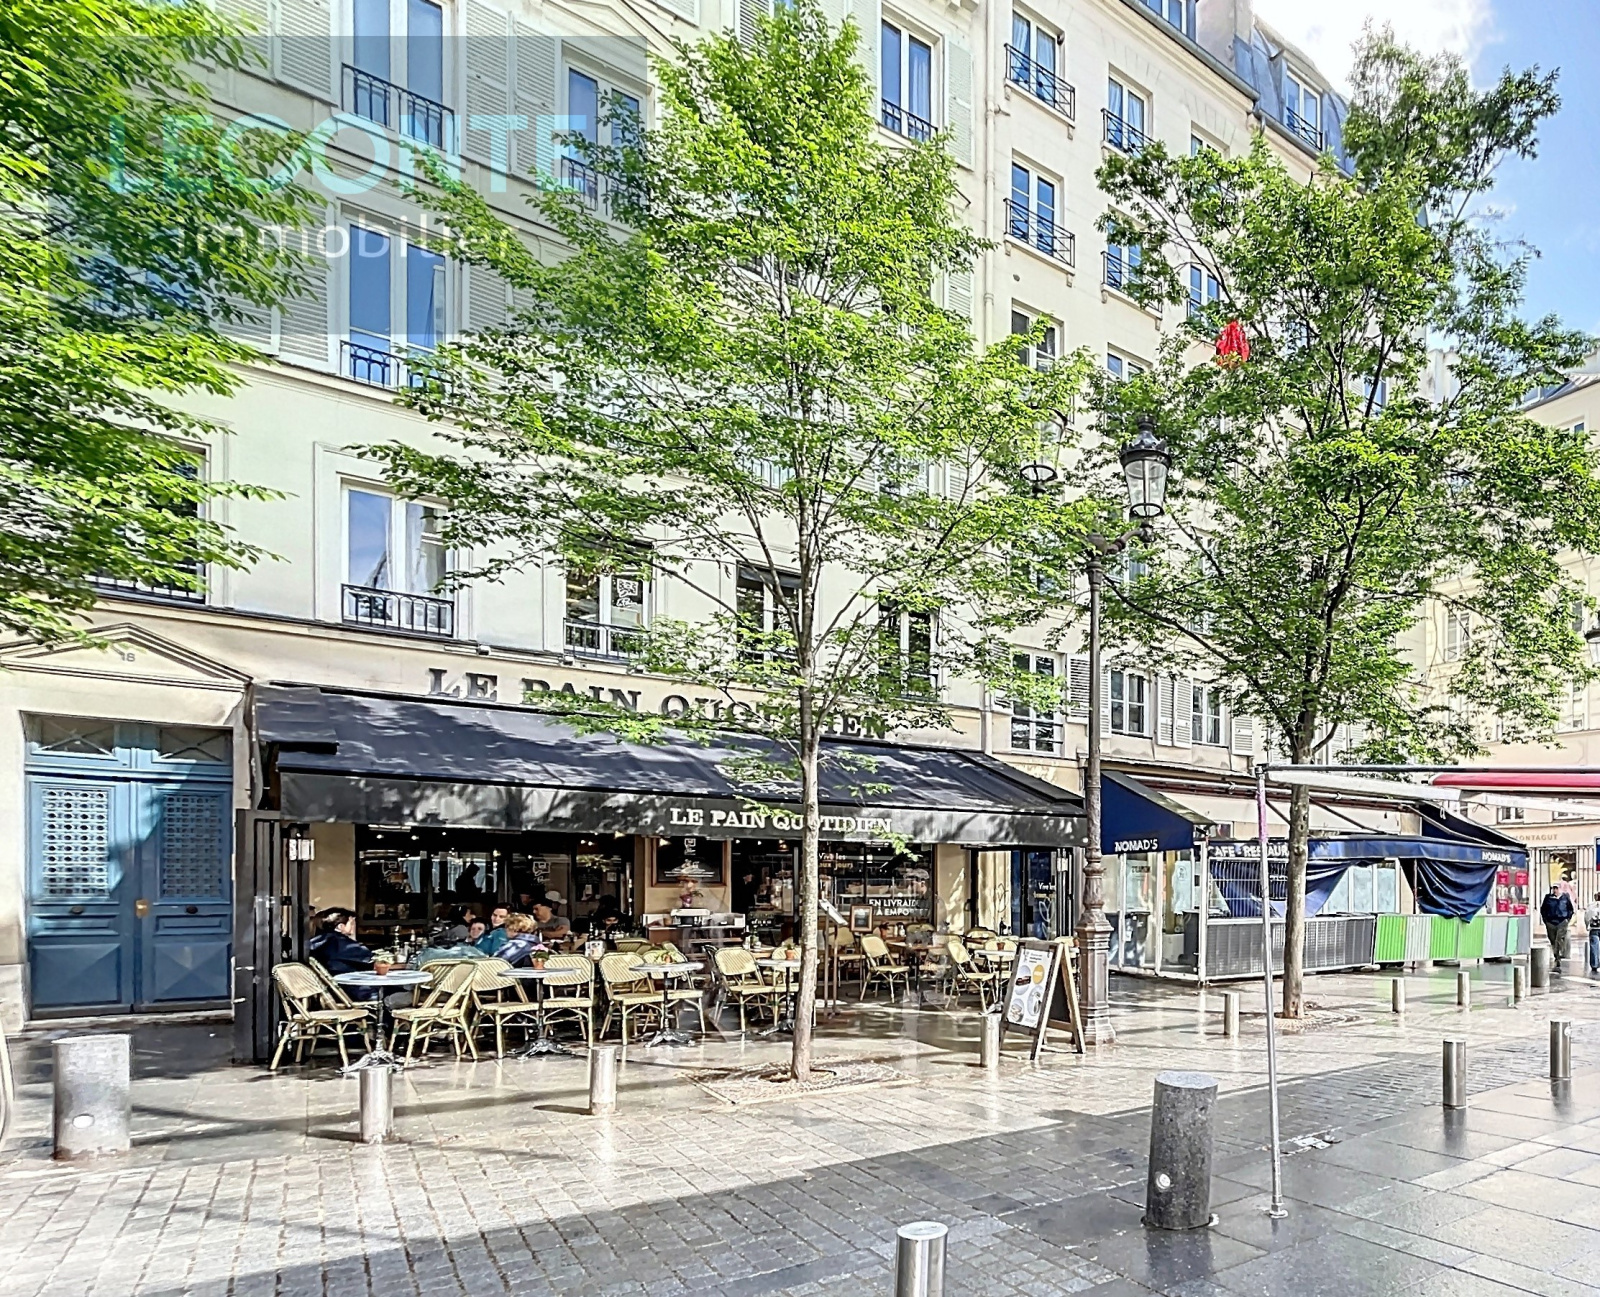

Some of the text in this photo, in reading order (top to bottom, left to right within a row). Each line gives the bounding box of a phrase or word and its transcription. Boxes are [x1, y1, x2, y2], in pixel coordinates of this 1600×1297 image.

[428, 667, 498, 702] LE
[521, 677, 642, 713] PAIN
[669, 807, 892, 833] LE PAIN QUTIDIEN
[1114, 838, 1159, 852] NOMAD'S
[1481, 851, 1512, 863] NOMAD'S
